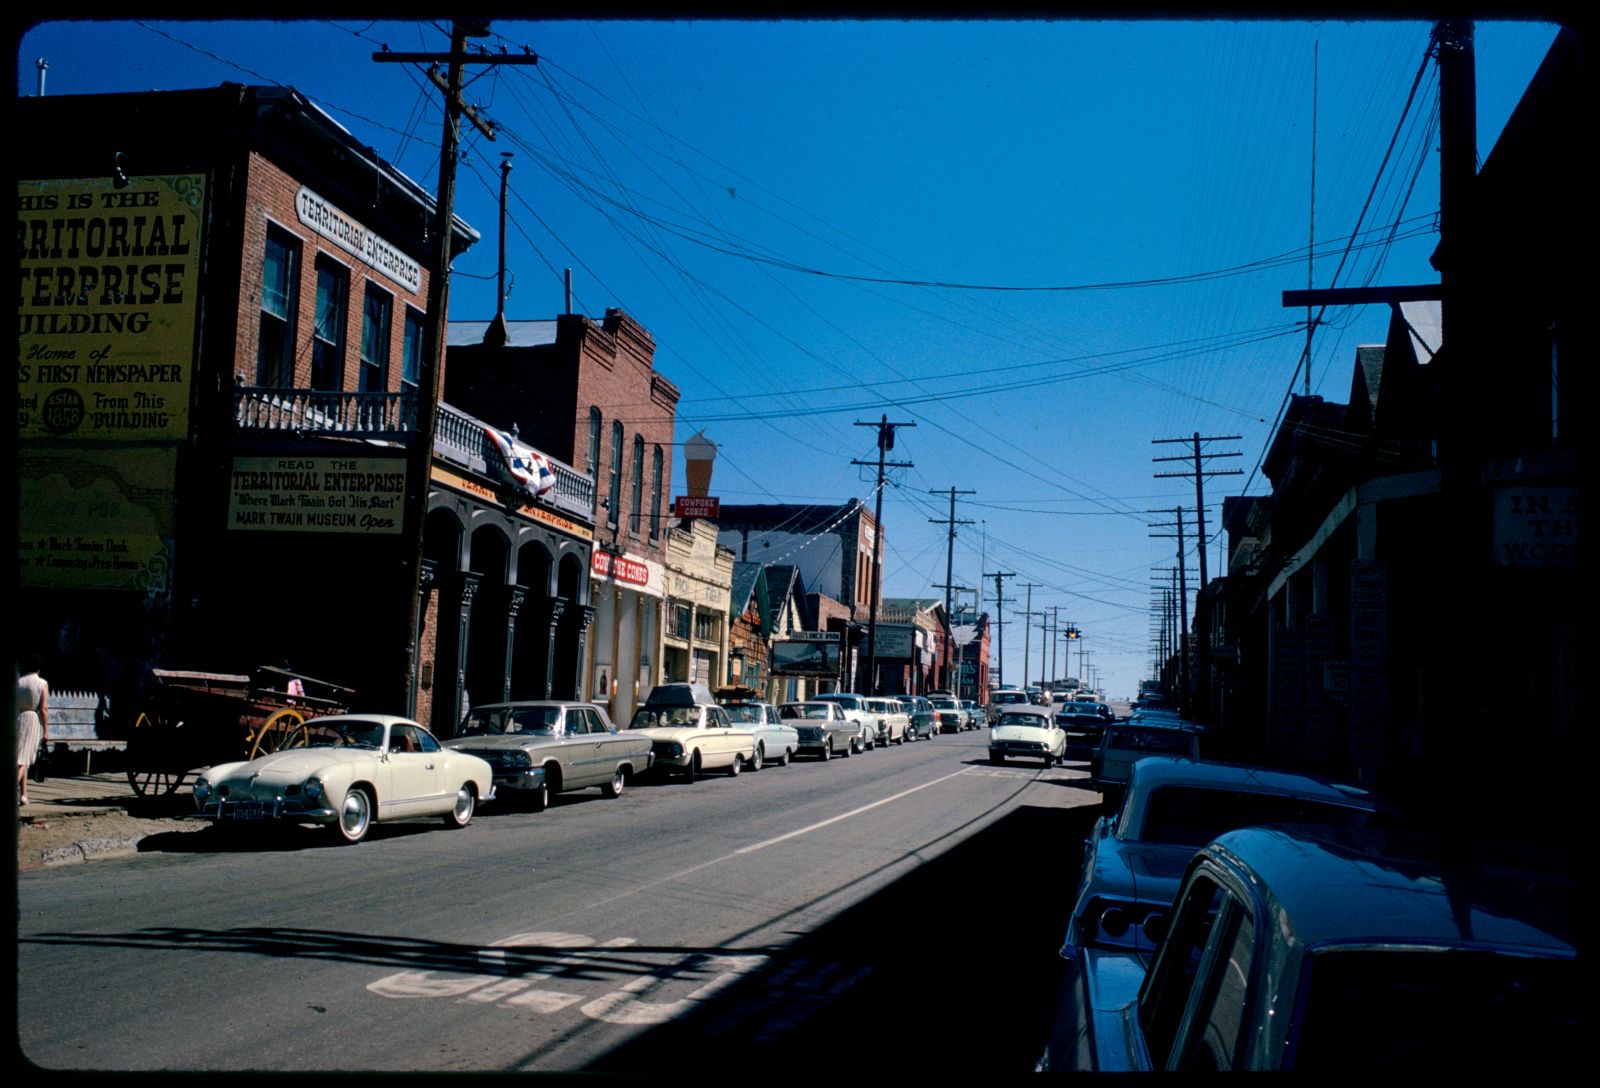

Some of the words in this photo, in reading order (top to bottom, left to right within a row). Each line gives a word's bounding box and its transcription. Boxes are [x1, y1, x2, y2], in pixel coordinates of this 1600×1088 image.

[66, 192, 93, 209] IS
[101, 191, 160, 208] THE
[301, 192, 364, 252] TERRITORIAL
[366, 236, 419, 287] ENTERPRISE
[25, 344, 77, 361] Home
[89, 343, 113, 364] of
[36, 364, 81, 383] FIRST
[86, 363, 183, 383] NEWSPAPER
[93, 392, 129, 409] From
[132, 391, 165, 409] This
[91, 412, 169, 429] BUILDING
[278, 460, 315, 470] READ
[330, 460, 357, 470] THE
[232, 471, 320, 491] TERRITORIAL
[323, 473, 404, 492] ENTERPRISE
[270, 493, 296, 507] Mark
[299, 495, 325, 508] Twain
[327, 494, 346, 508] Got
[348, 494, 368, 509] His
[679, 498, 715, 508] COWPOKE
[1510, 495, 1552, 514] IN
[236, 511, 267, 525] MARK
[269, 512, 303, 526] TWAIN
[306, 513, 356, 527] MUSEUM
[359, 513, 395, 531] Open
[521, 504, 574, 531] ENTERPRISE
[684, 507, 709, 517] CONES
[593, 552, 625, 578] COWOKE
[627, 563, 647, 583] CONES
